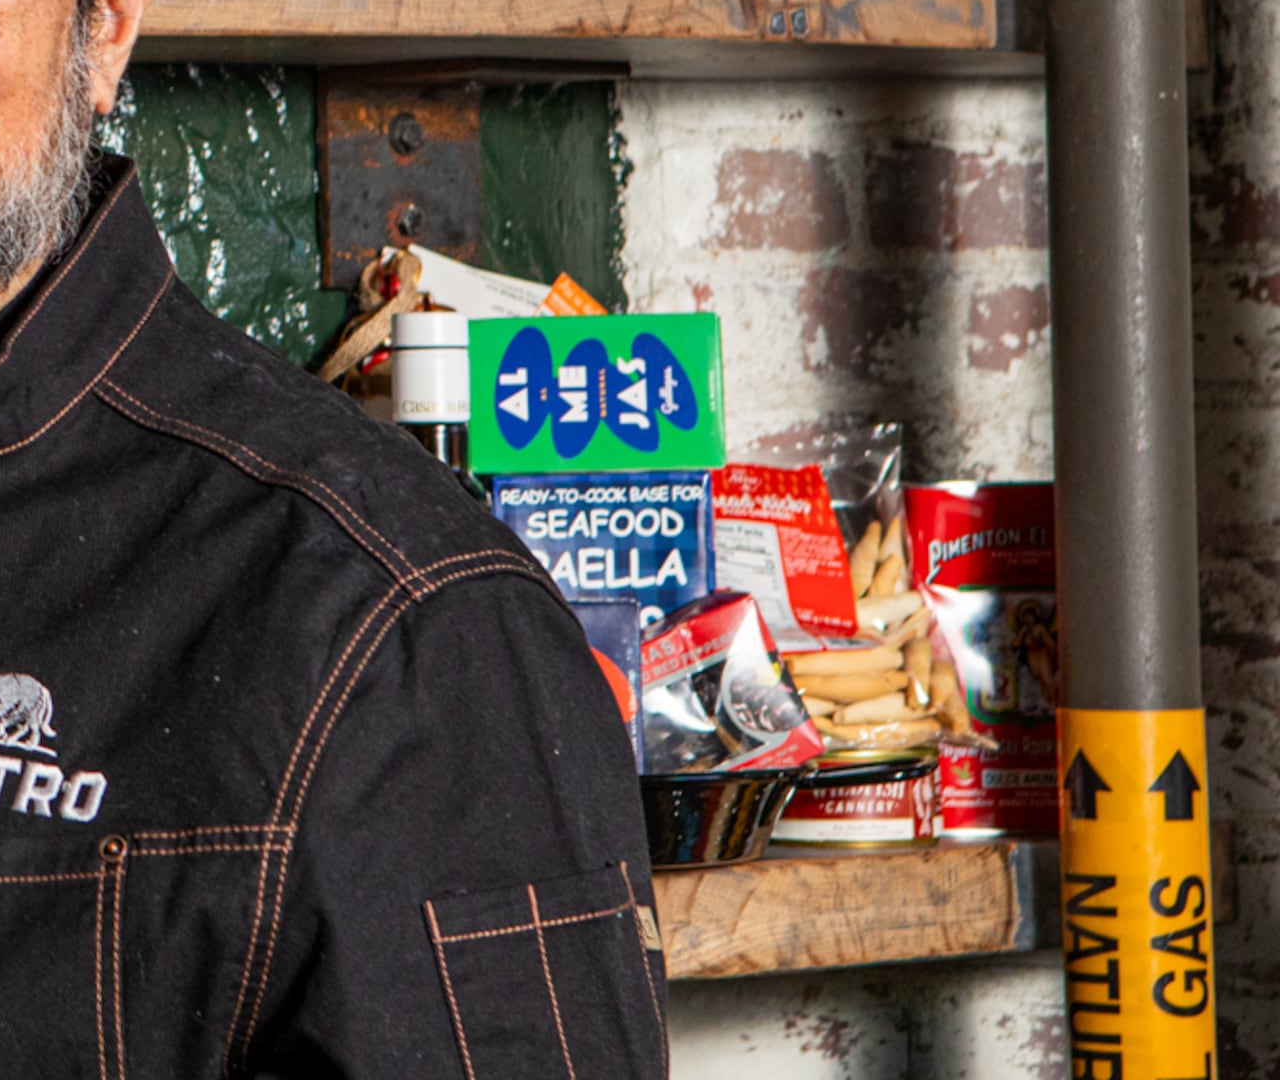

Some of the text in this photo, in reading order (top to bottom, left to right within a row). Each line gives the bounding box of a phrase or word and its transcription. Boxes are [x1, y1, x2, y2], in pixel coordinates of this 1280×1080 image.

[499, 367, 530, 422] AL
[558, 365, 588, 423] ME
[600, 368, 608, 418] NATURAL
[617, 356, 650, 430] JAS
[501, 485, 704, 506] READY-TO-COOK BASE FOR
[526, 508, 684, 539] SEAFOOD
[927, 528, 1019, 584] PIMENTON
[1150, 875, 1209, 1018] GAS
